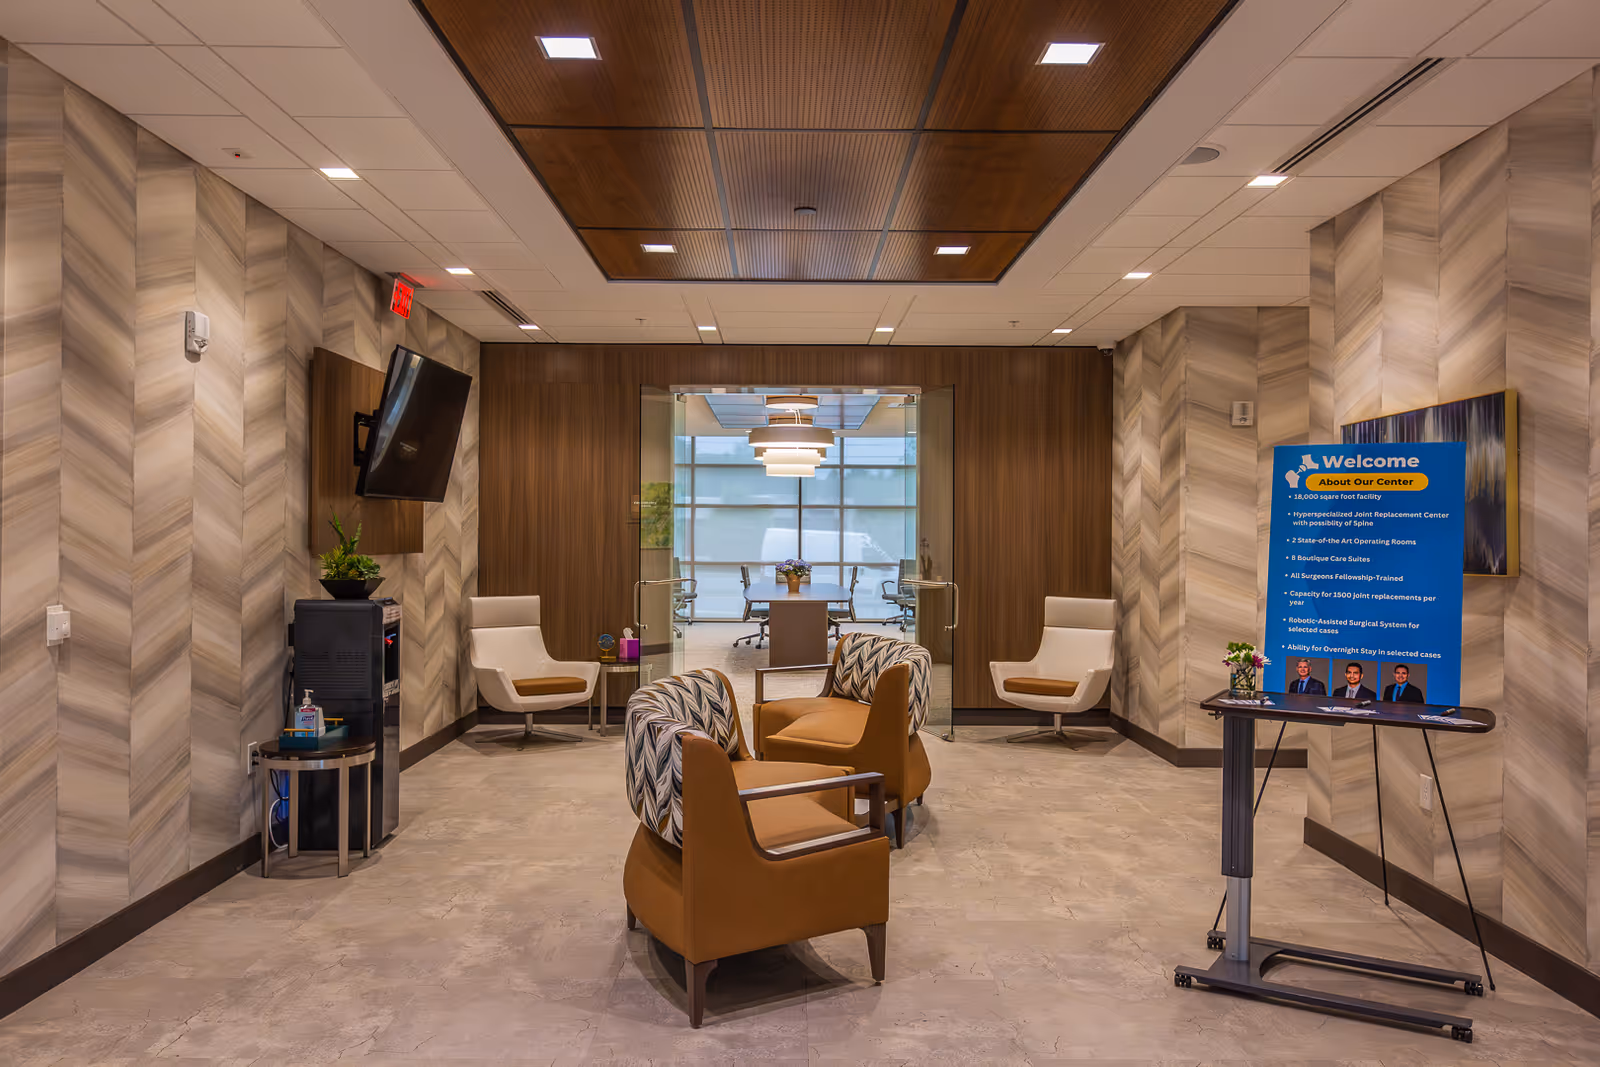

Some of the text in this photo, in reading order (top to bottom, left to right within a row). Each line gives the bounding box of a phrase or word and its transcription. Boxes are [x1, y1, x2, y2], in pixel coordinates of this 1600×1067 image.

[1322, 454, 1419, 469] Welcome
[1353, 519, 1374, 528] Spine
[1354, 537, 1390, 546] Operating
[1297, 554, 1329, 563] Boutique
[1302, 572, 1334, 581] Surgeons
[1290, 590, 1320, 599] Capacity
[1372, 593, 1421, 602] replacements
[1349, 619, 1378, 628] Surgical
[1380, 620, 1407, 629] System
[1287, 643, 1310, 653] Ability
[1324, 645, 1359, 655] Overnight
[1360, 647, 1377, 657] Stay
[1387, 649, 1418, 658] selected
